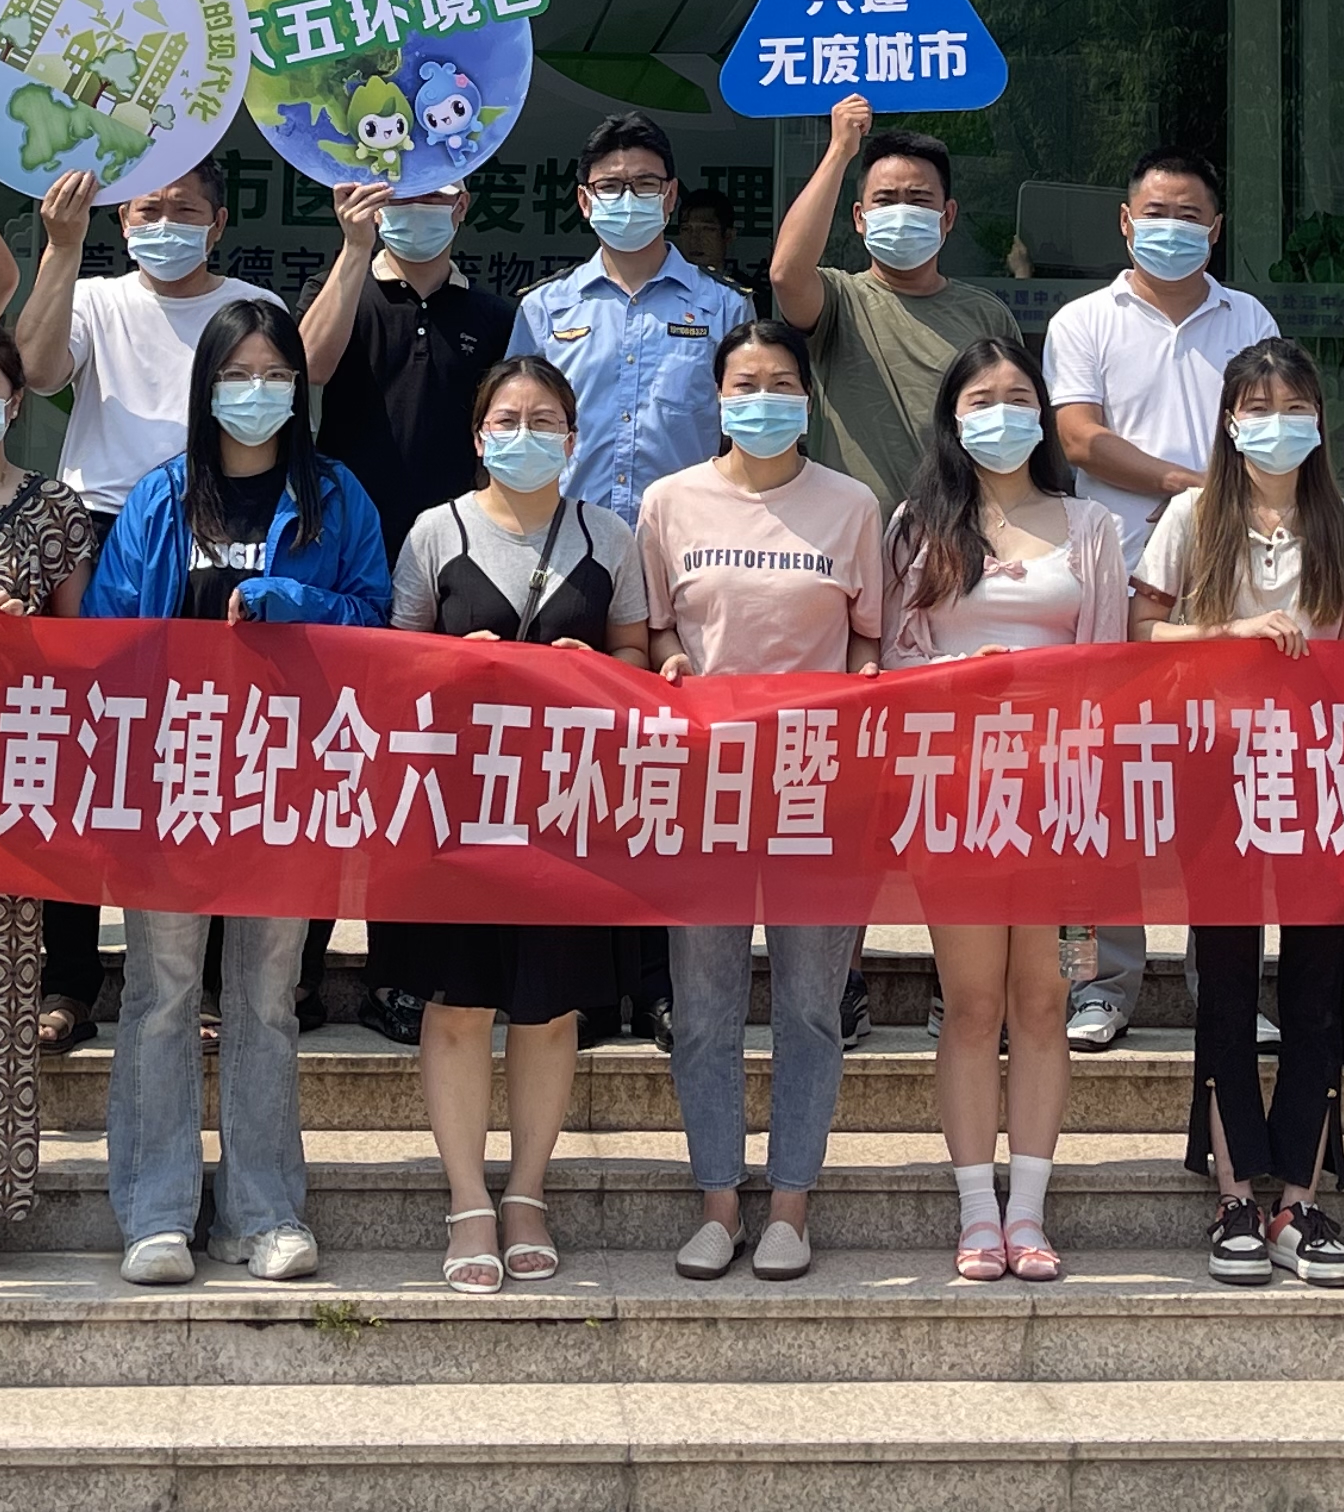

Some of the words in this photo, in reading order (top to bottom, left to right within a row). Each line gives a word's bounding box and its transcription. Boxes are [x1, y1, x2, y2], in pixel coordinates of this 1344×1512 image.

[758, 29, 968, 86] 无废城市
[683, 548, 835, 577] OUTFITOFTHEDAY
